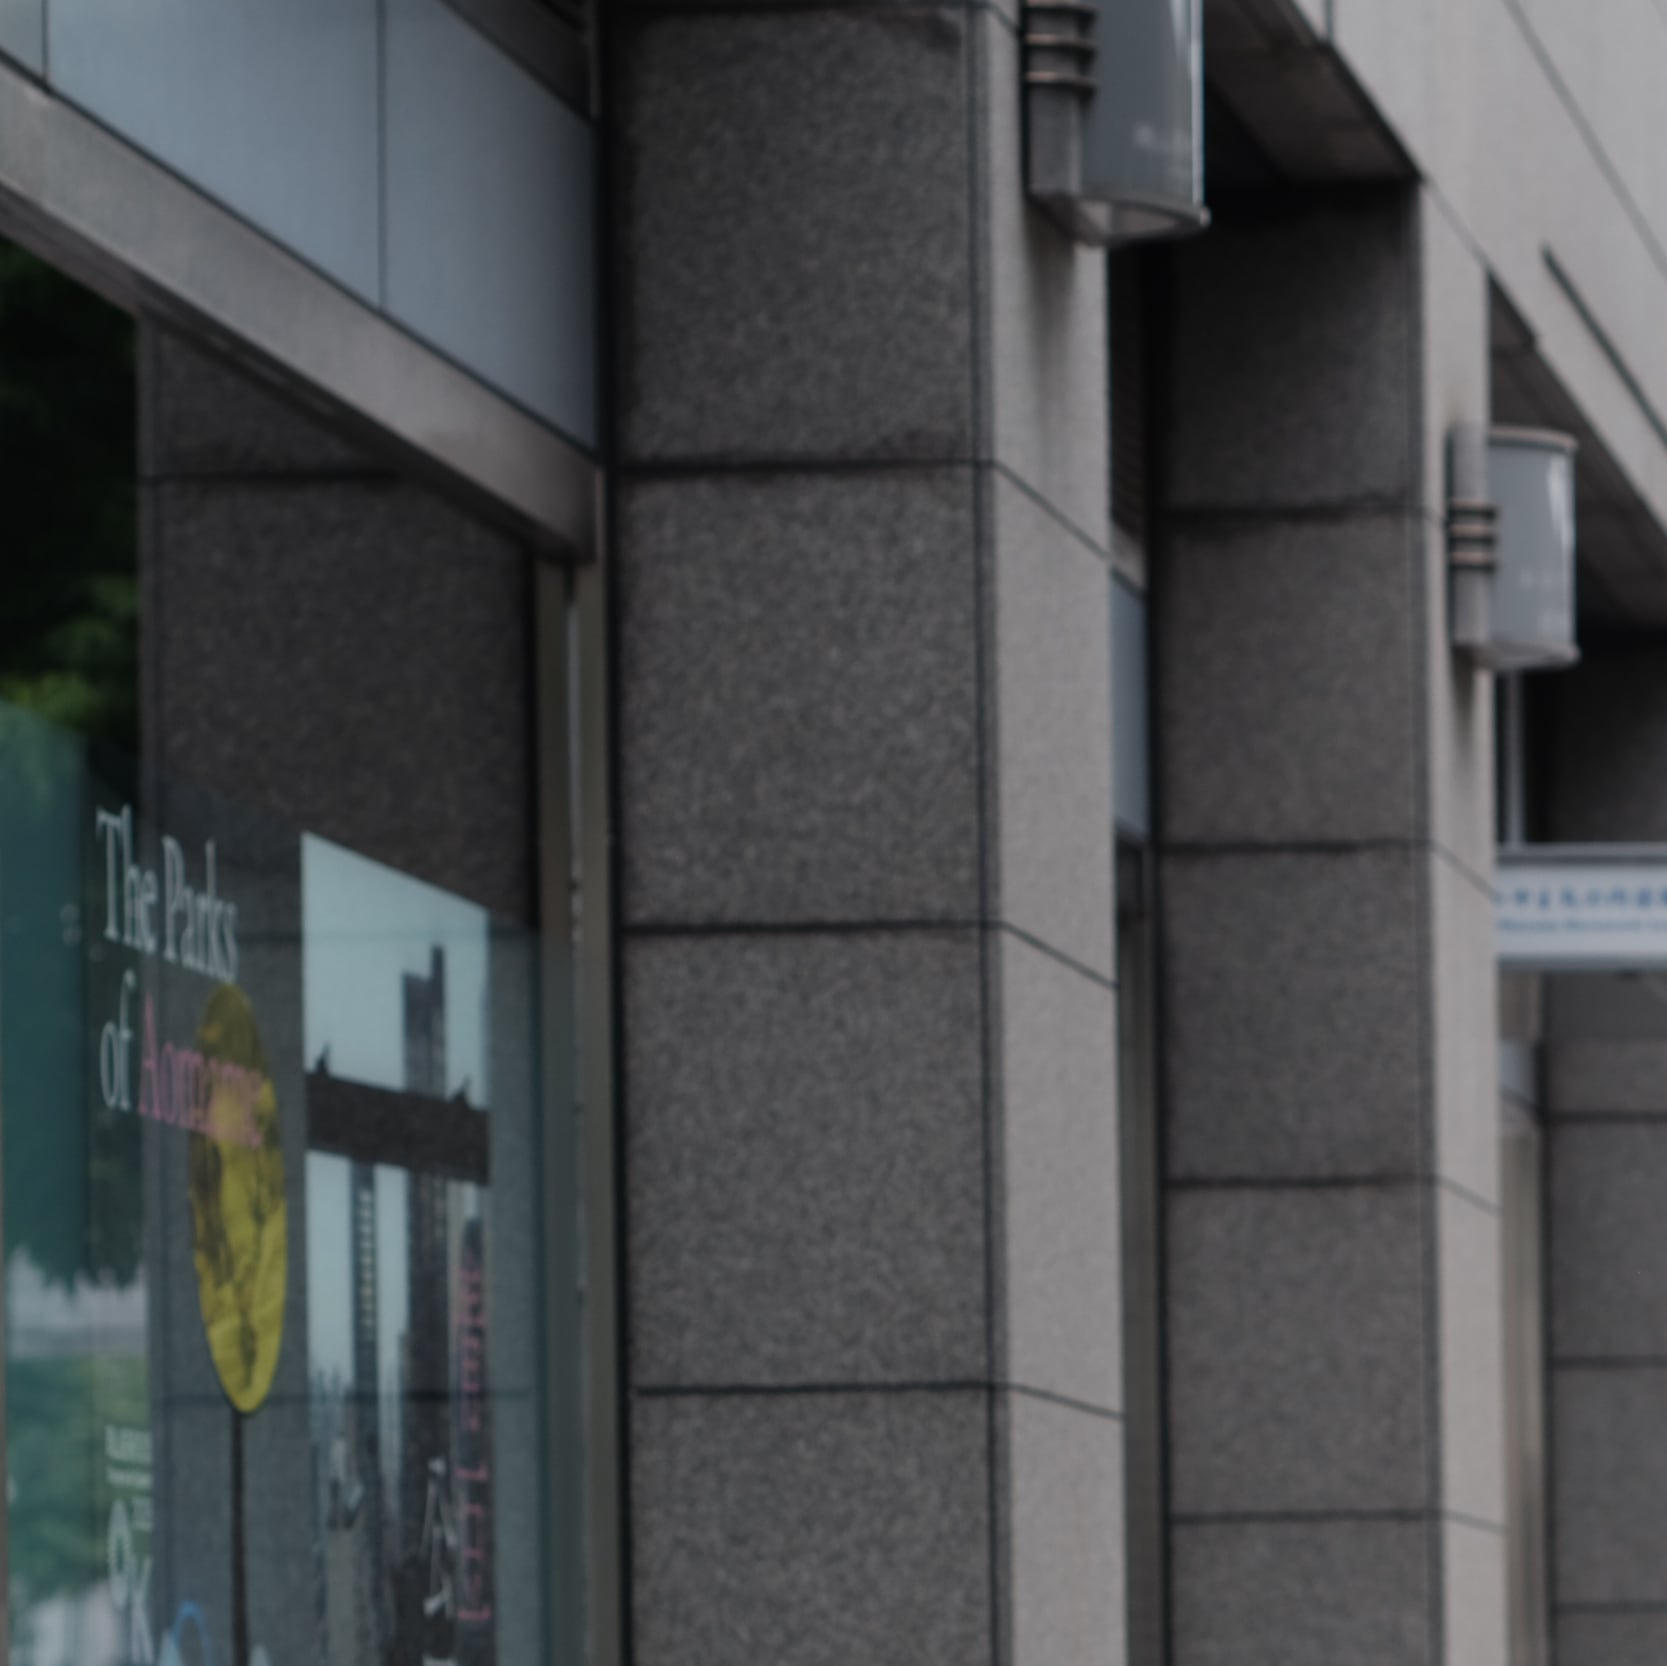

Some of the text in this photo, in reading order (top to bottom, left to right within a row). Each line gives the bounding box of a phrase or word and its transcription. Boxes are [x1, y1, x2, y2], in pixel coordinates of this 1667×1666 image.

[95, 803, 239, 984] The Parks
[100, 968, 136, 1112] of
